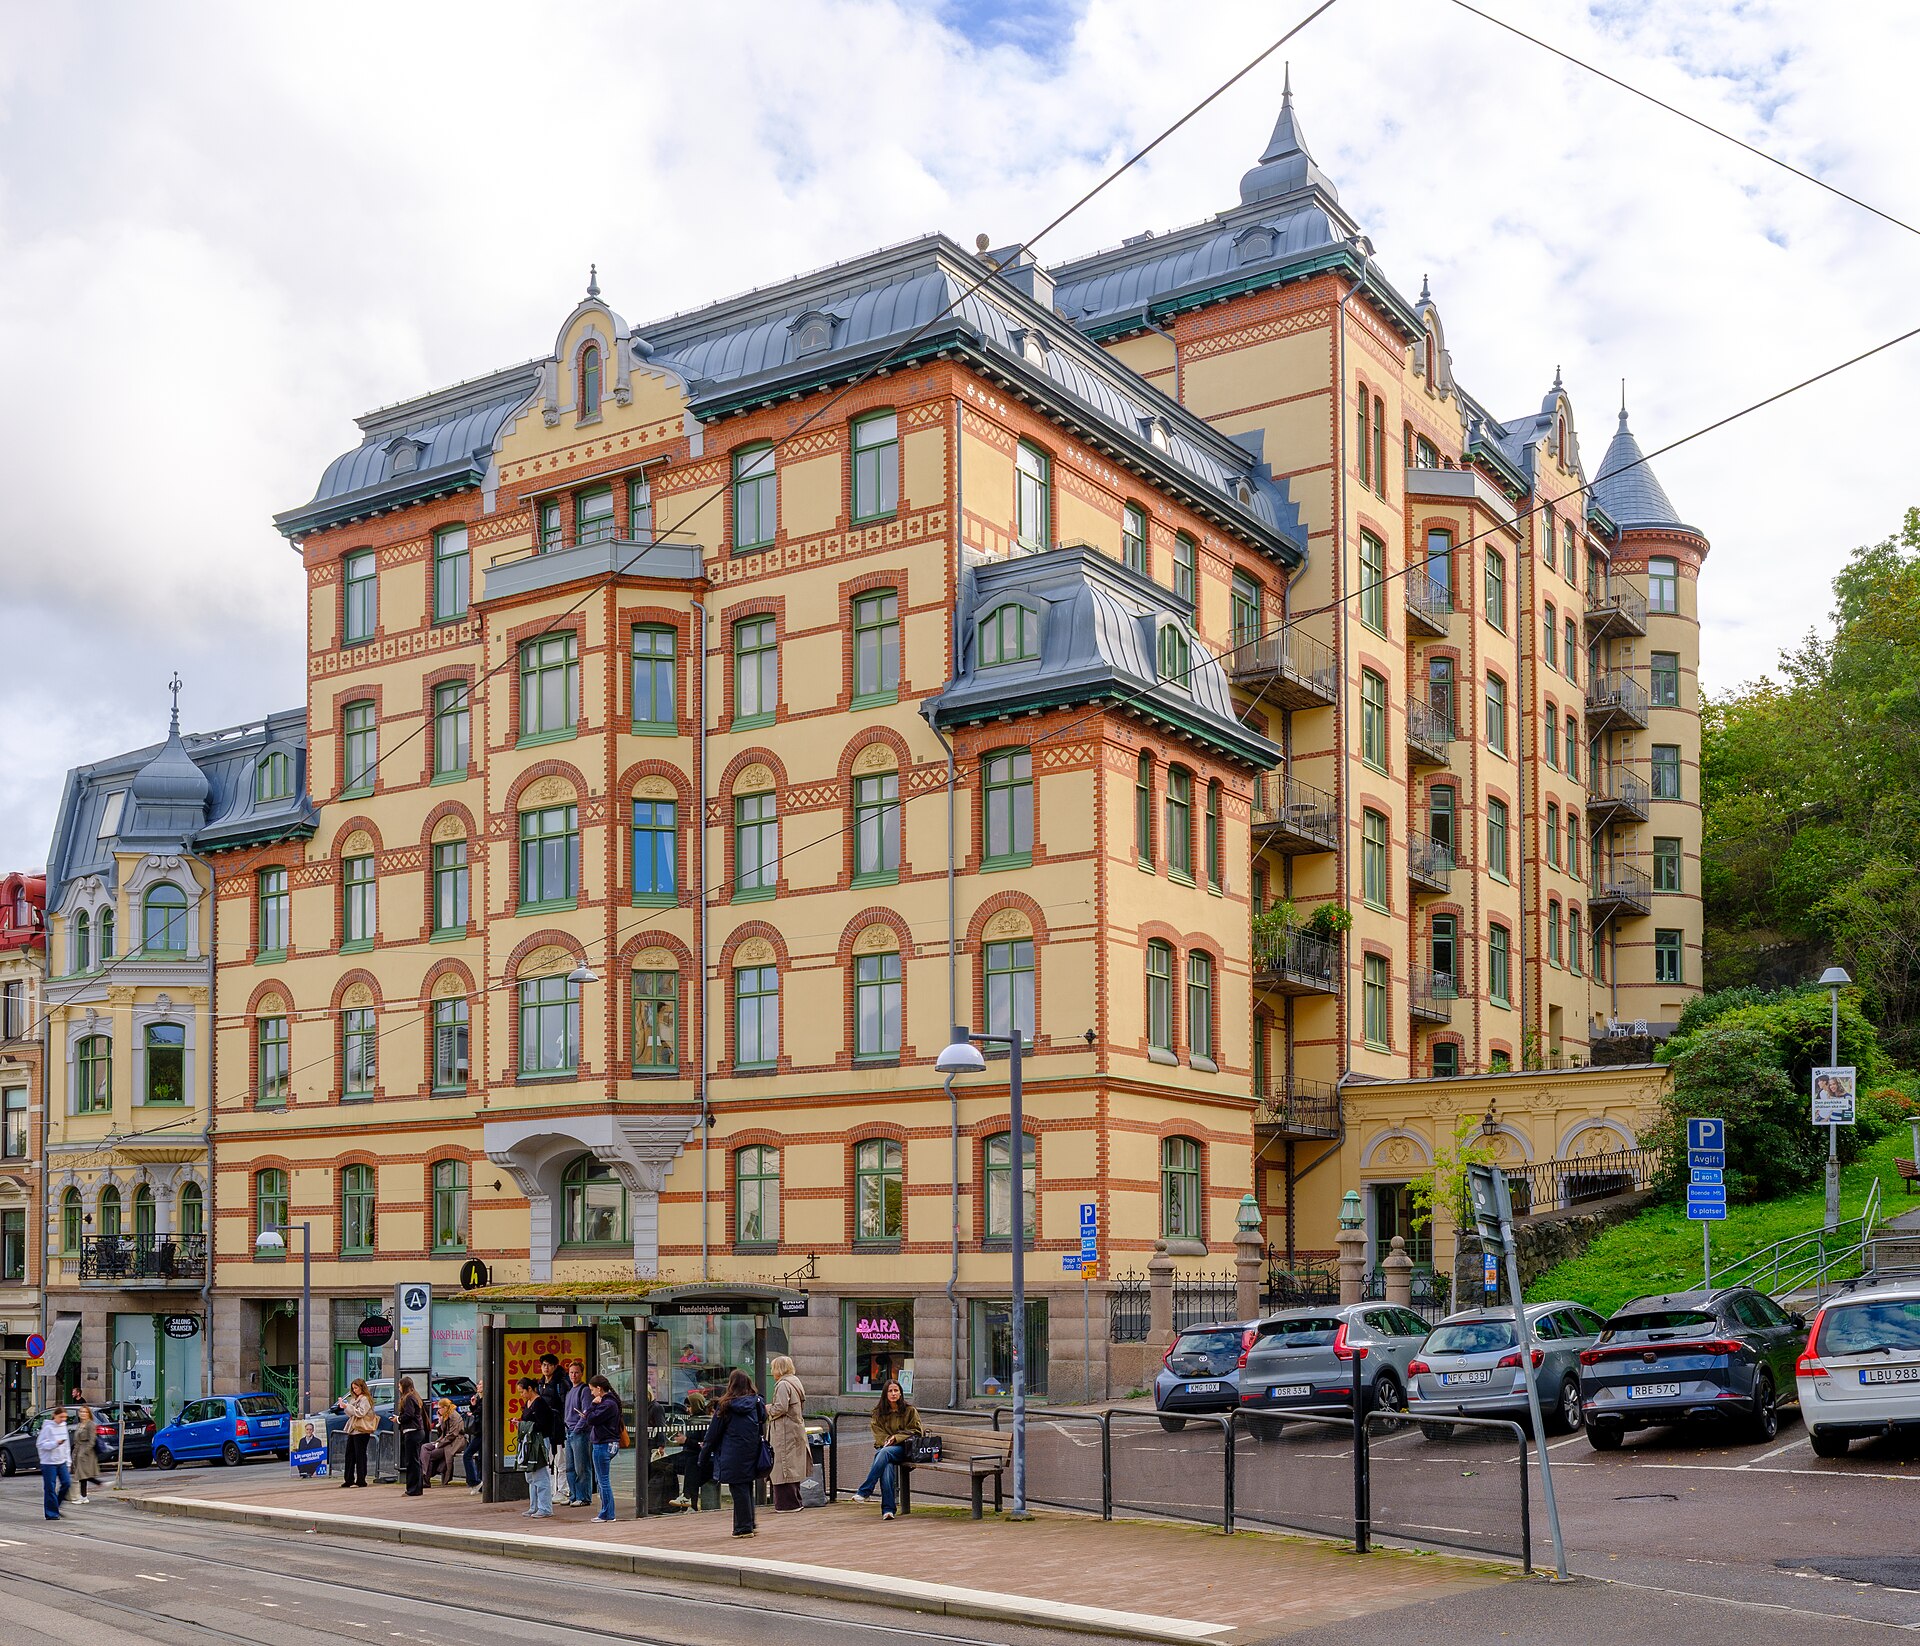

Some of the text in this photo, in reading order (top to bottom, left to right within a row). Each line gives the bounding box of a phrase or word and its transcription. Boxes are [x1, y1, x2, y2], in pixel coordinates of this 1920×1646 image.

[1699, 1122, 1716, 1146] P
[1694, 1155, 1720, 1165] Avgift
[1084, 1205, 1093, 1223] P
[410, 1292, 422, 1307] A
[679, 1305, 730, 1314] Handelshögskolan
[861, 1318, 900, 1332] BARA
[507, 1335, 572, 1356] VI GÖR
[1448, 1372, 1485, 1382] NFK 639
[1869, 1369, 1918, 1381] LBU 988
[1635, 1384, 1676, 1396] RBE 57C
